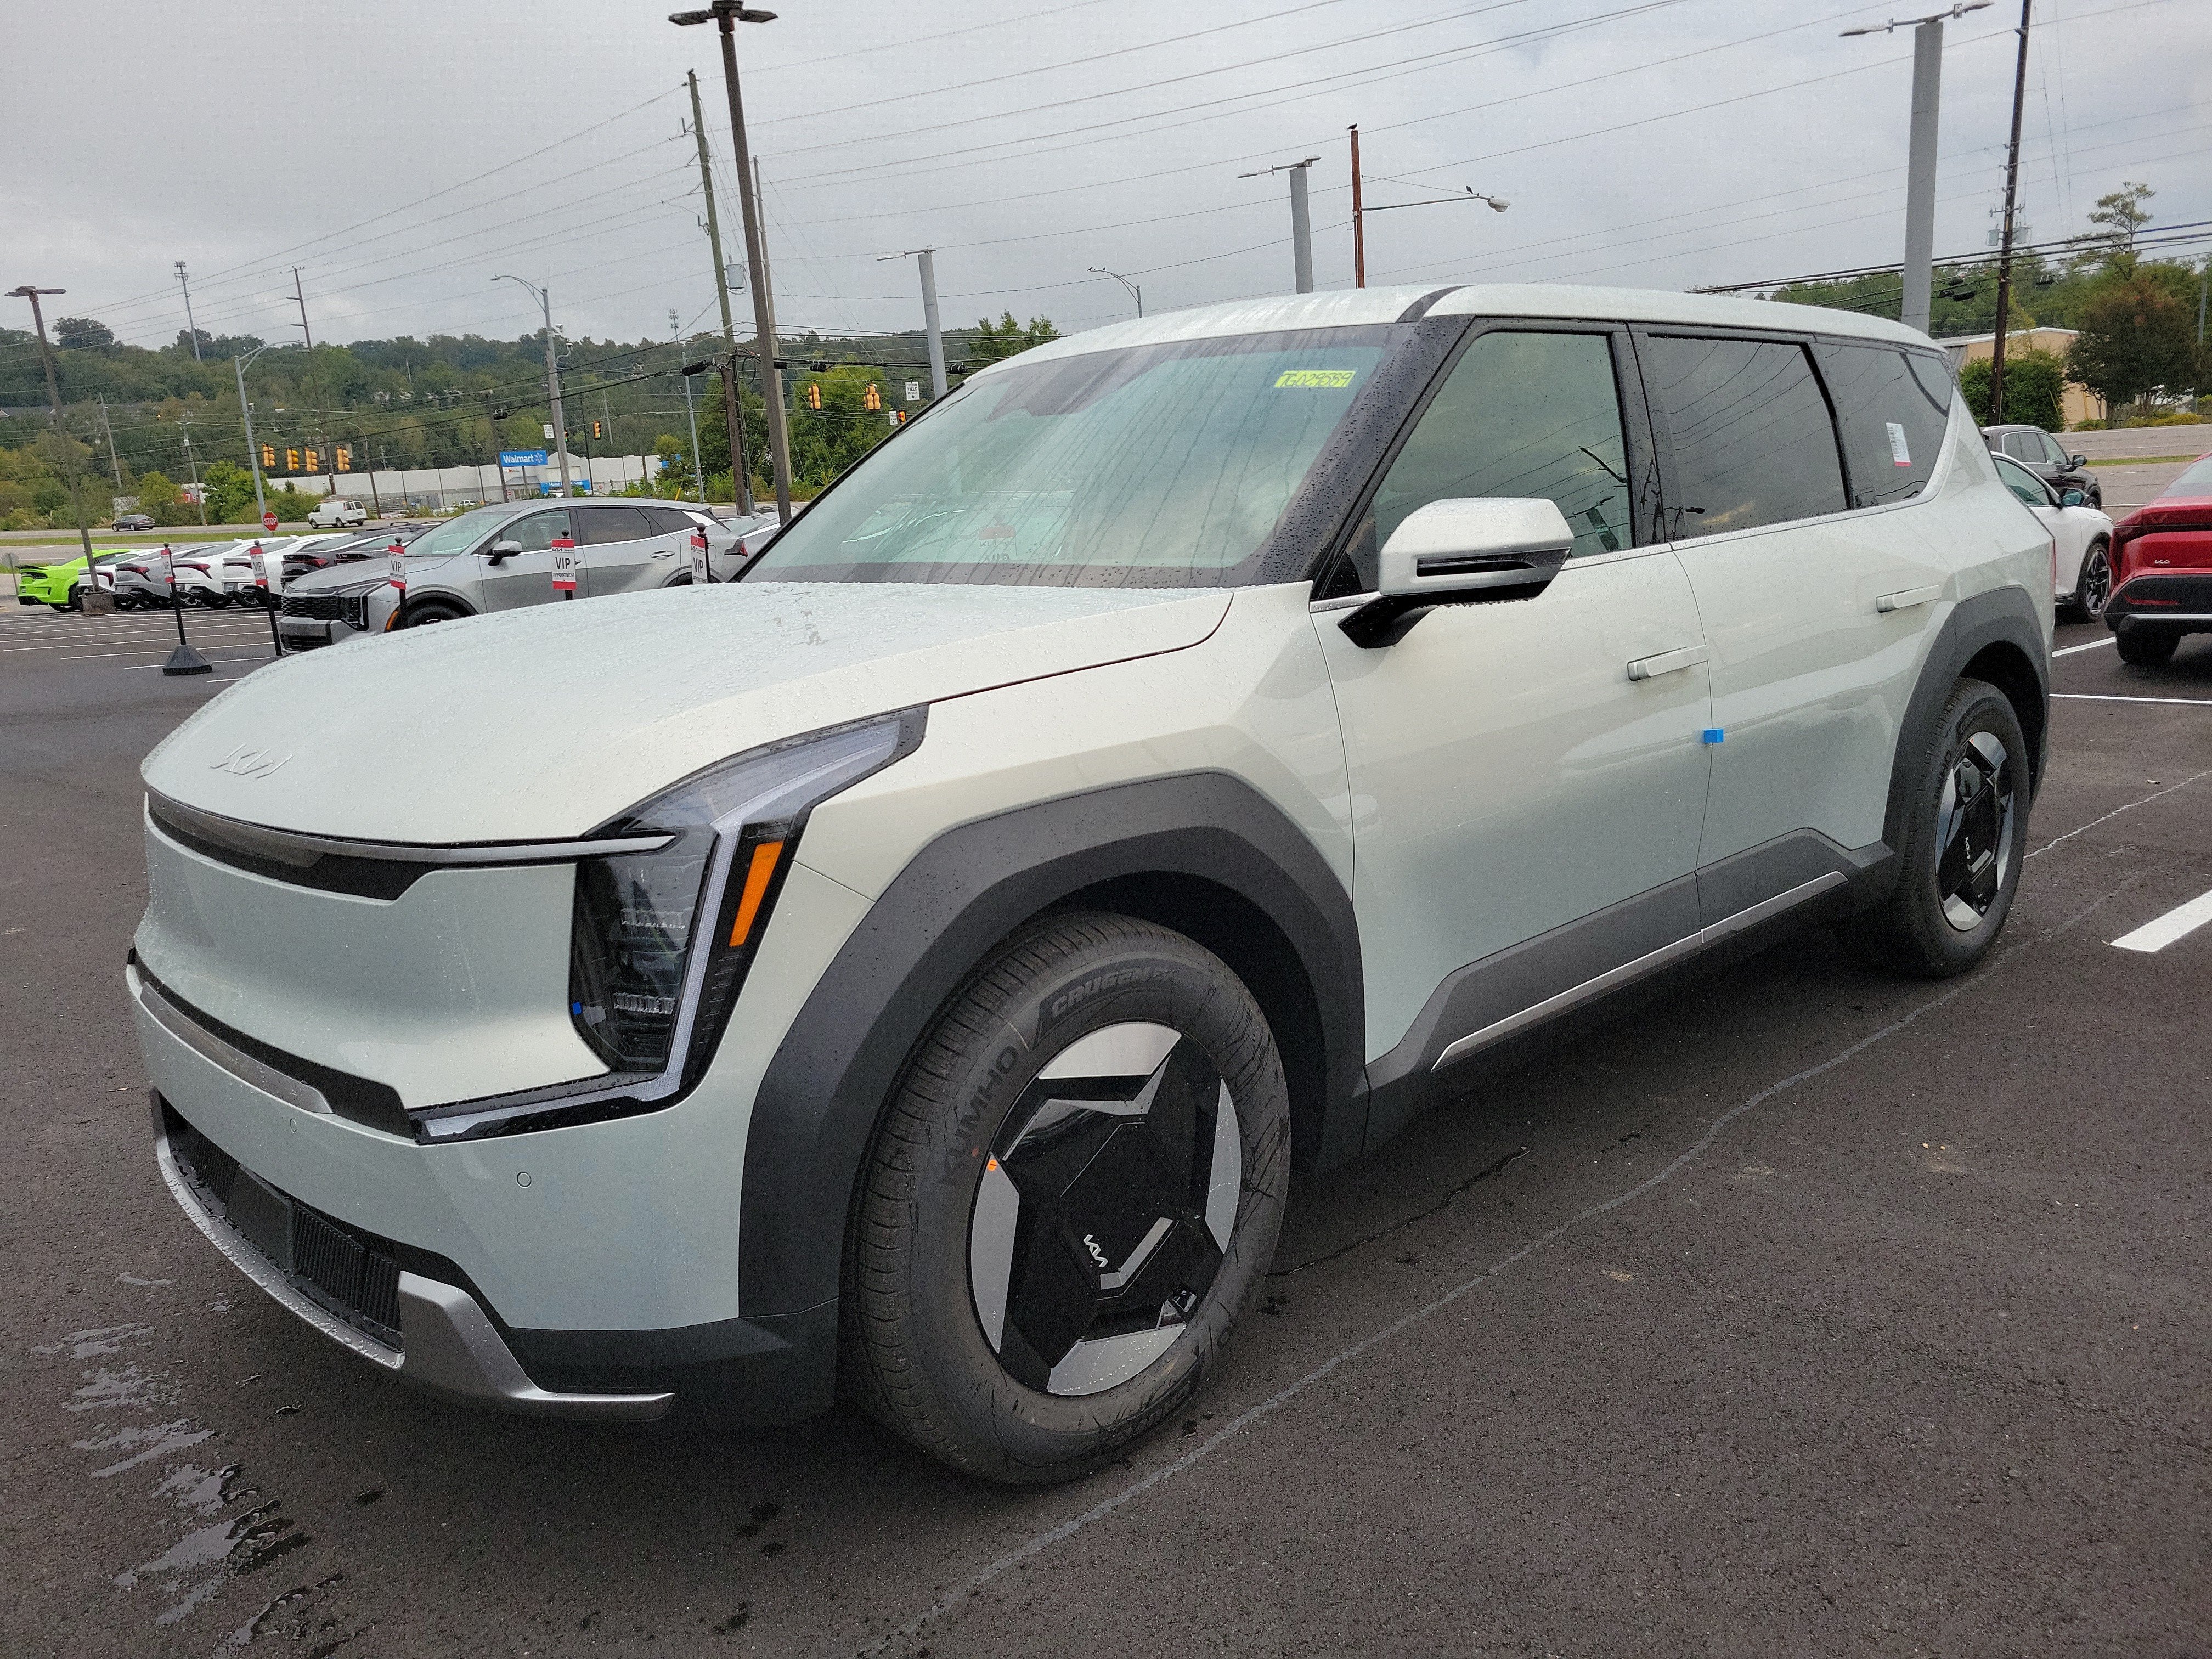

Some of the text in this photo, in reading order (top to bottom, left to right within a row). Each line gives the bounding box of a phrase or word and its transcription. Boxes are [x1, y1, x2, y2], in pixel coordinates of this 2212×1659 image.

[503, 454, 535, 463] Walmart
[253, 561, 262, 571] VIP
[391, 560, 402, 572] VIP
[555, 557, 571, 570] VIP
[693, 557, 703, 574] VIP
[1052, 967, 1151, 1018] CRUGEN
[938, 1045, 1019, 1187] KUMHO
